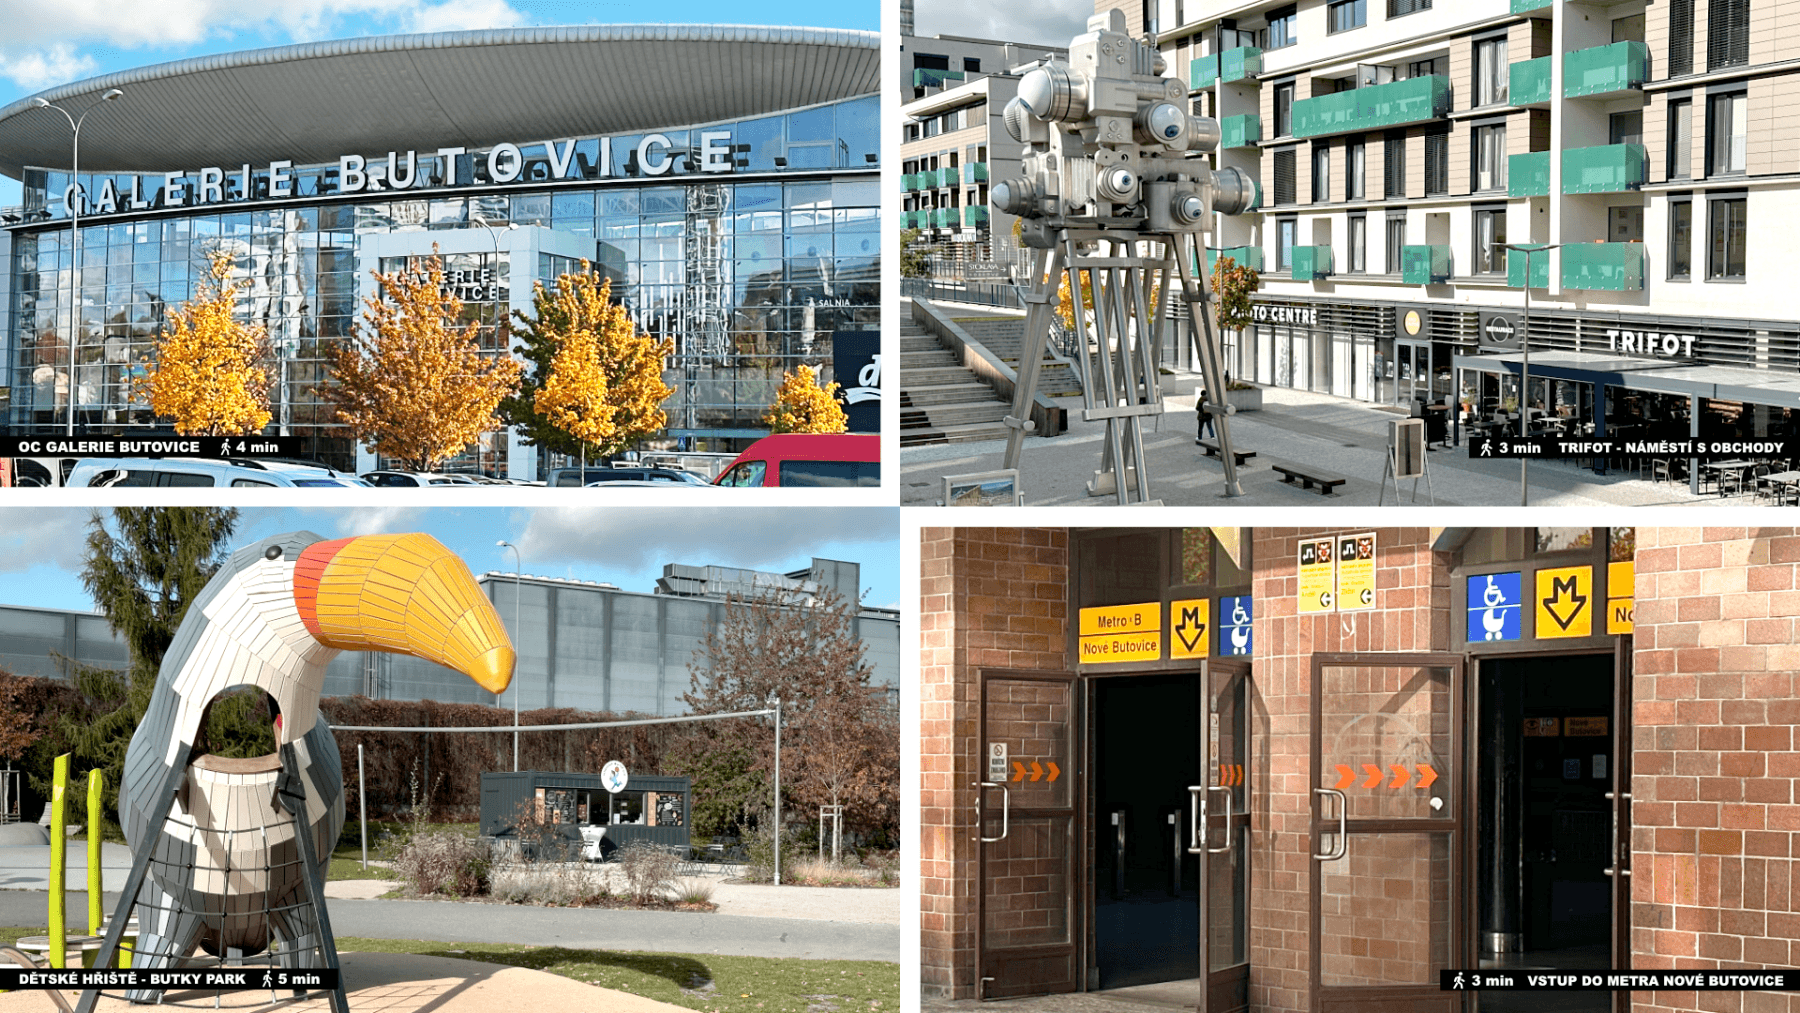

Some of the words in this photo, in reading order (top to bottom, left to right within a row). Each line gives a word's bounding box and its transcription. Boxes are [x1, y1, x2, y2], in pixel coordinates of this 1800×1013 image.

[63, 159, 292, 217] GALERIE
[339, 131, 732, 193] BUTOVICE
[1271, 307, 1317, 324] CENTRE
[1606, 329, 1696, 357] TRIFOT
[1098, 615, 1127, 628] Metro
[1134, 613, 1142, 626] B
[1084, 641, 1109, 655] Nové
[1112, 638, 1157, 654] Butovice
